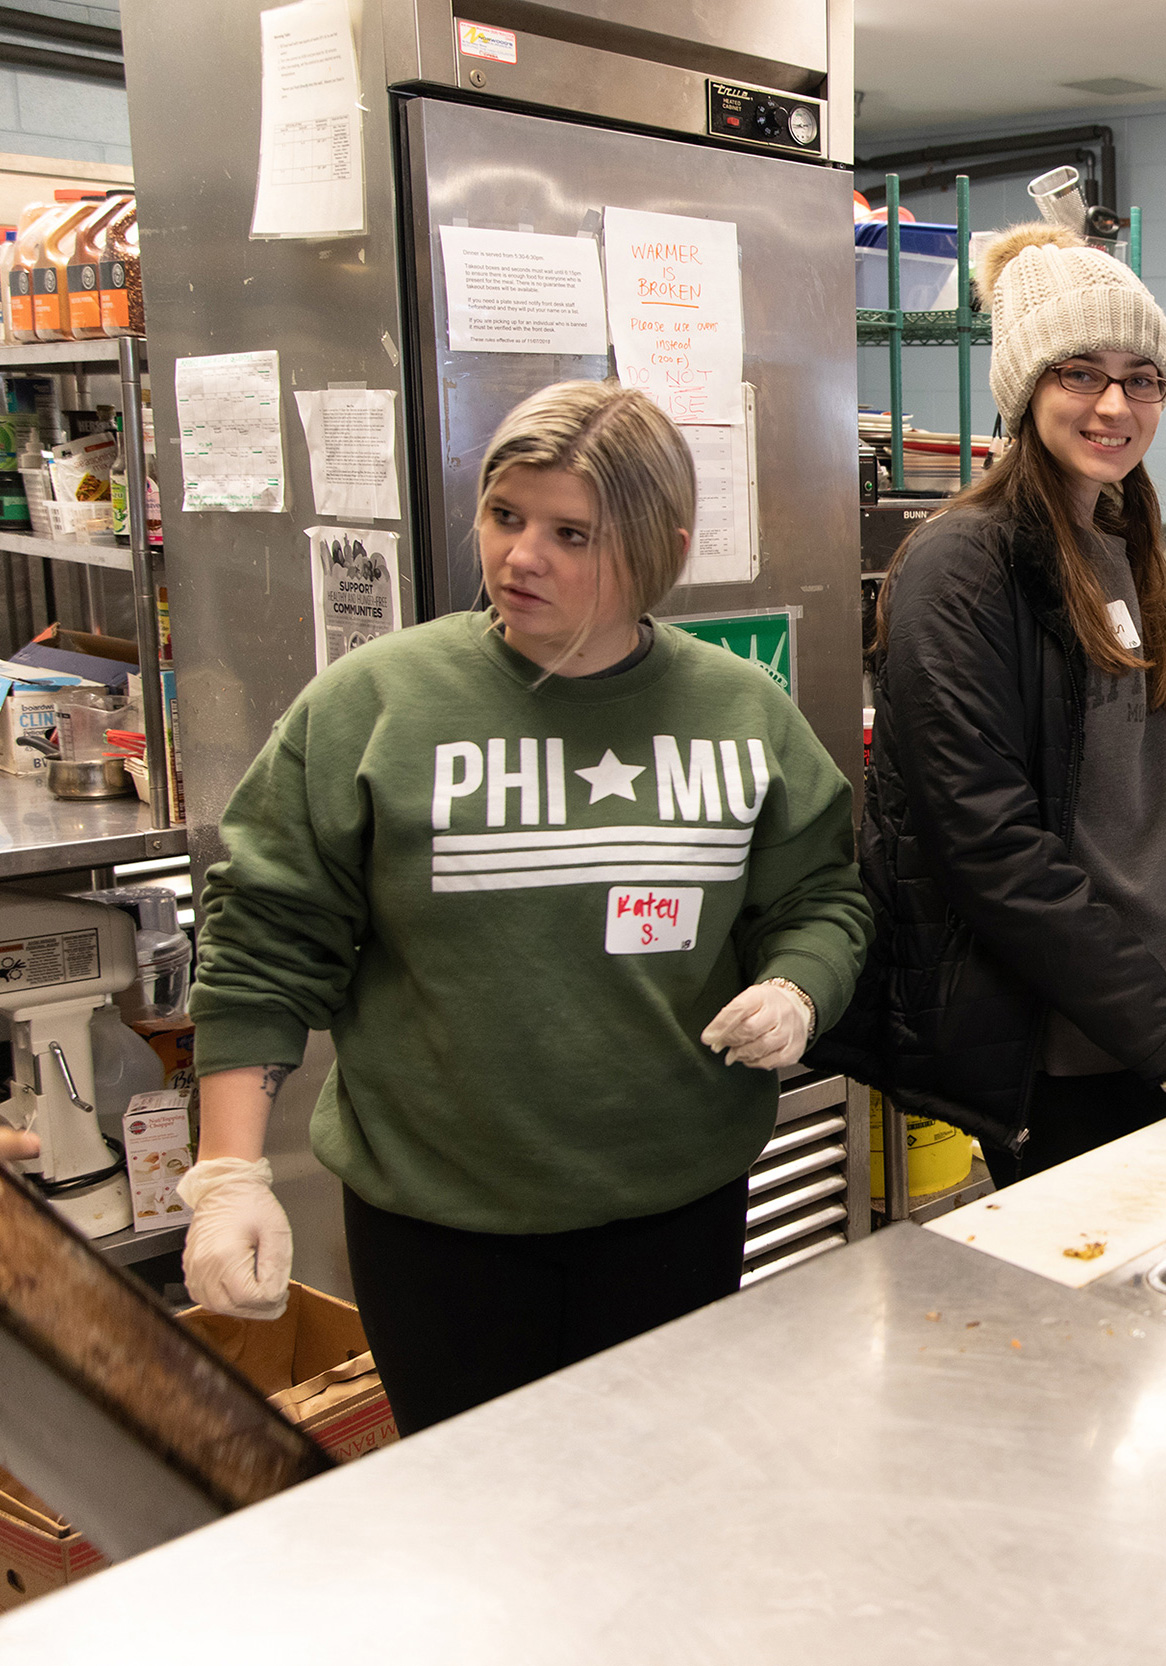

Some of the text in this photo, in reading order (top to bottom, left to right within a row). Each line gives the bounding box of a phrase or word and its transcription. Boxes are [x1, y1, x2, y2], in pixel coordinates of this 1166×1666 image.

[722, 103, 742, 112] CABINET
[723, 98, 742, 106] HEATED
[631, 242, 703, 265] WARMER
[663, 266, 676, 281] IS
[637, 278, 702, 301] BROKEN
[630, 318, 665, 332] Please
[674, 322, 690, 333] use
[655, 337, 692, 351] instead
[626, 366, 713, 386] DO NOT
[656, 394, 708, 415] USE
[93, 462, 109, 471] mix
[903, 510, 927, 520] BUNN
[339, 580, 373, 595] SUPPORT
[327, 590, 347, 603] HEALTHY
[19, 711, 54, 728] CLIN
[431, 734, 770, 831] PHI MU
[616, 892, 680, 927] Katey
[641, 923, 659, 945] S.
